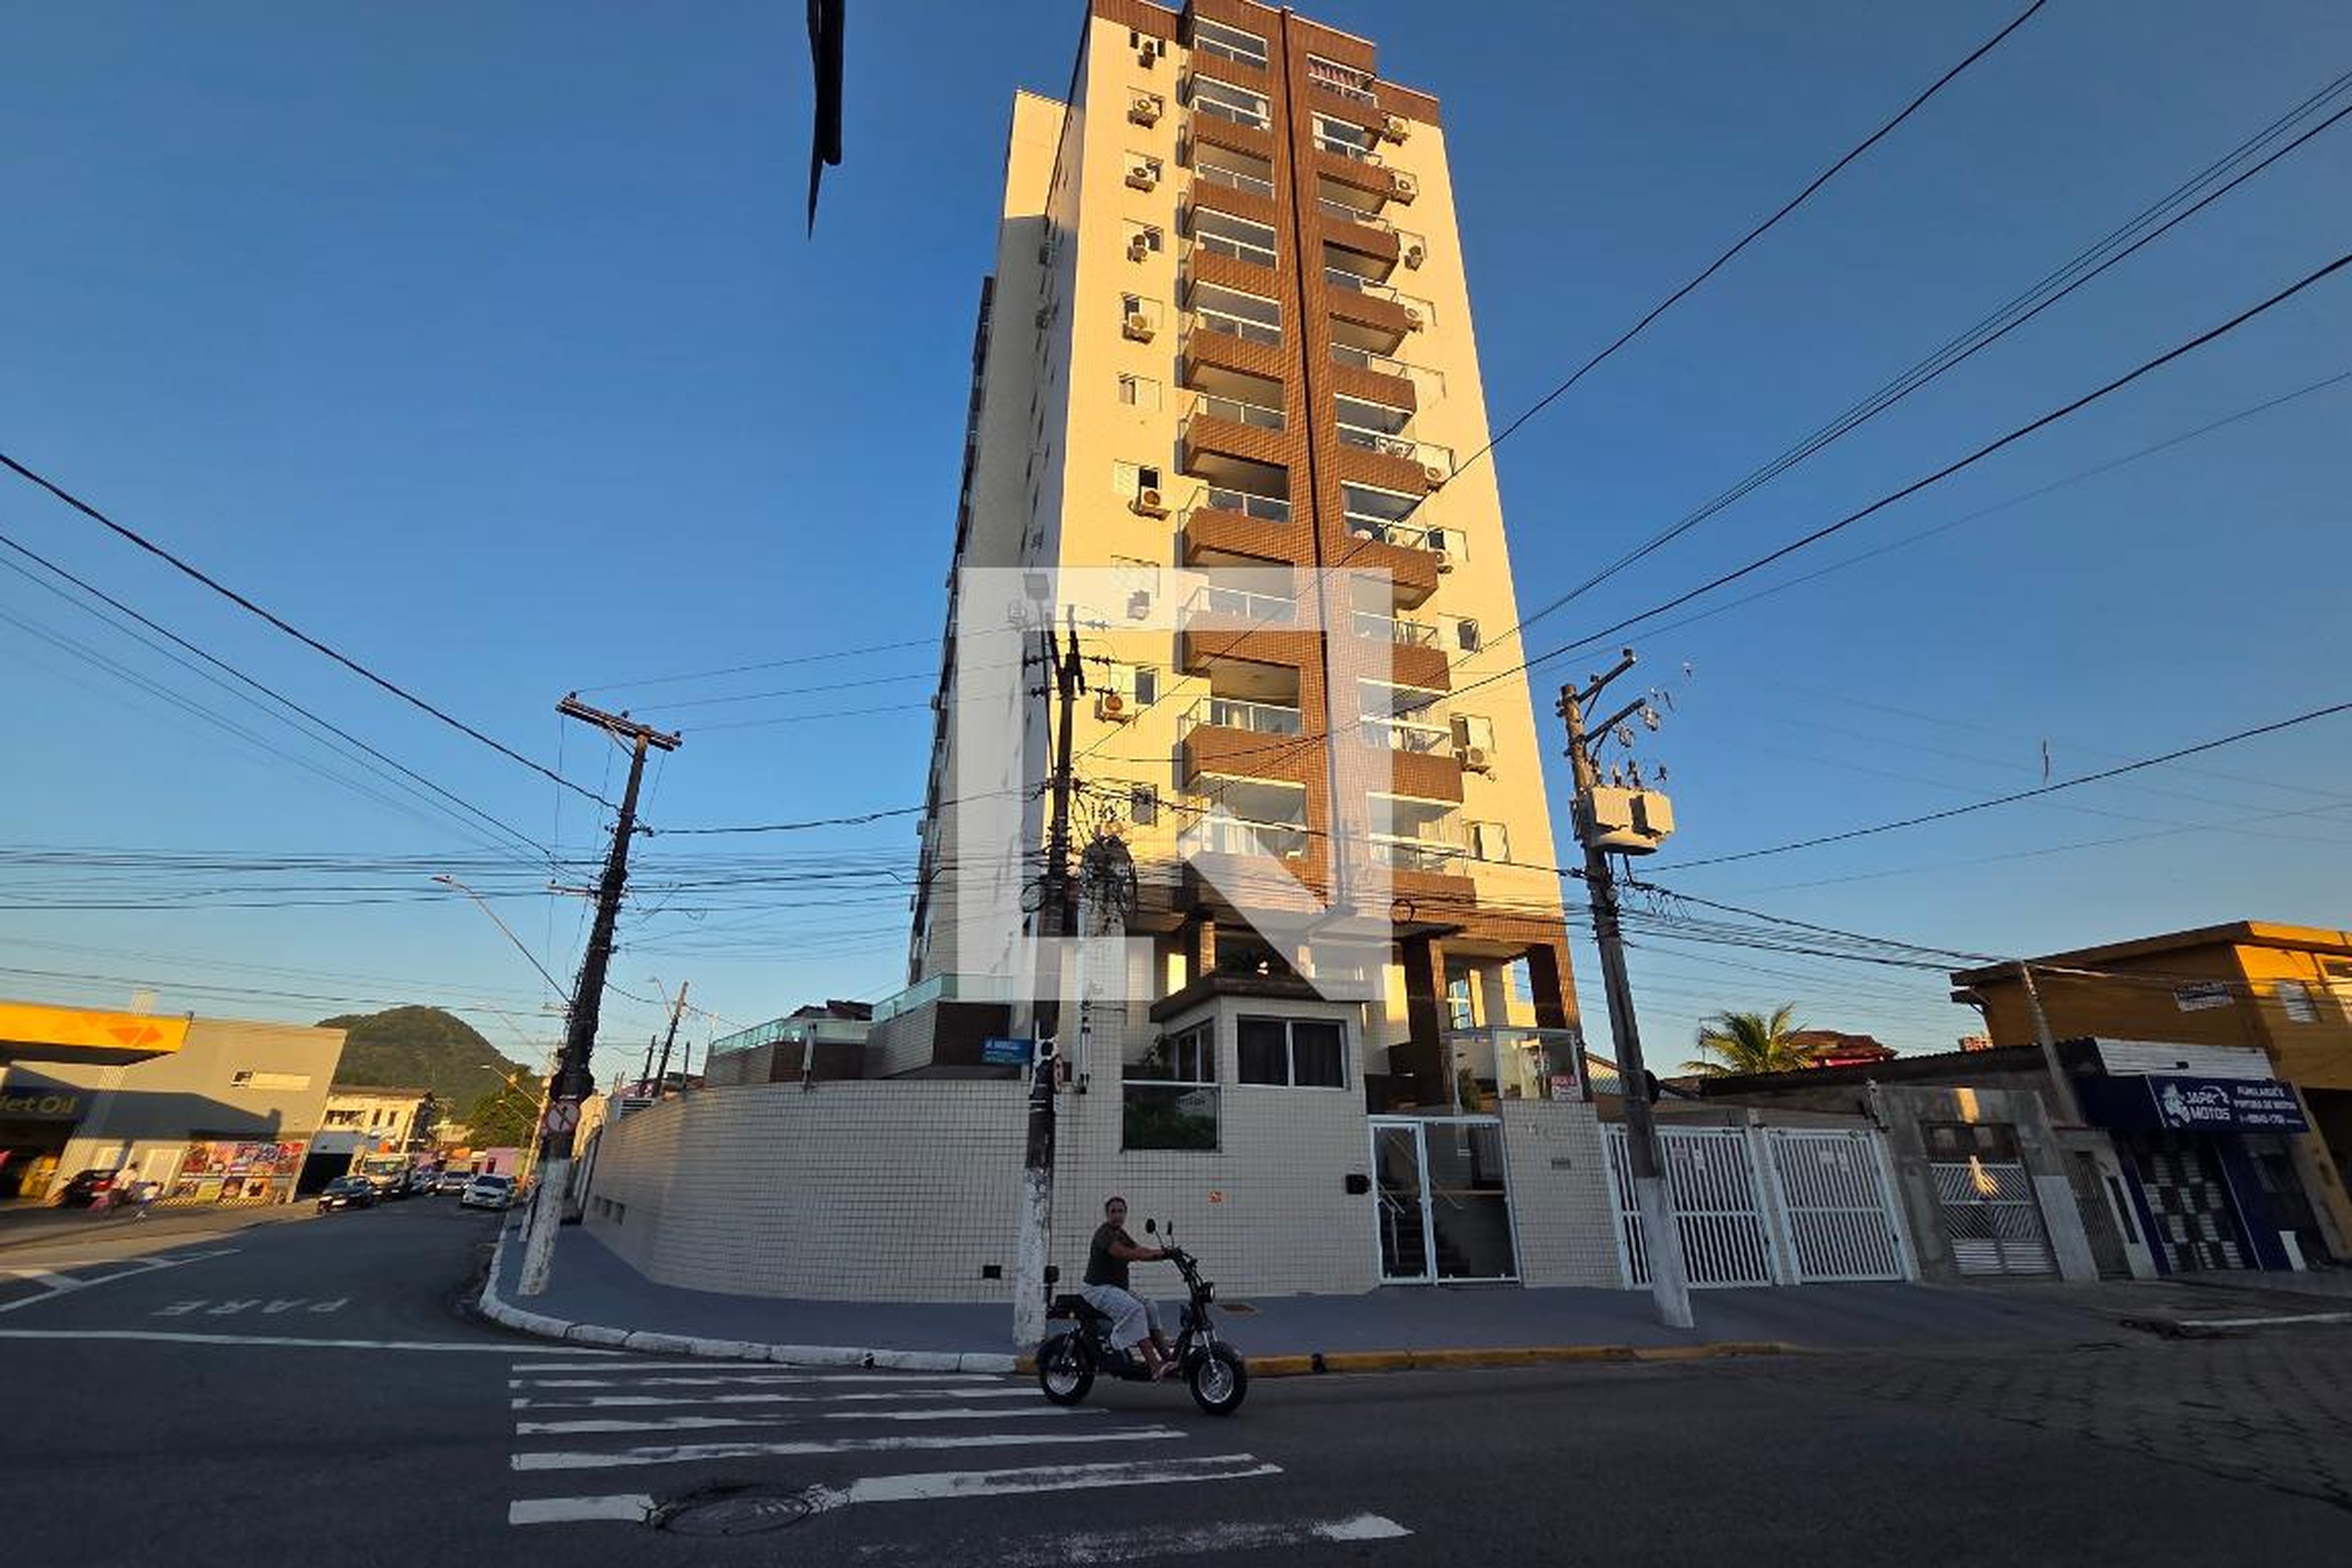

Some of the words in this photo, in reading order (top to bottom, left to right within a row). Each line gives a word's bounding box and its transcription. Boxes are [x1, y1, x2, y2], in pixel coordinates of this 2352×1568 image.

[38, 1096, 77, 1114] Oil
[2190, 1106, 2231, 1120] MOTOS
[149, 1298, 349, 1315] PARE
